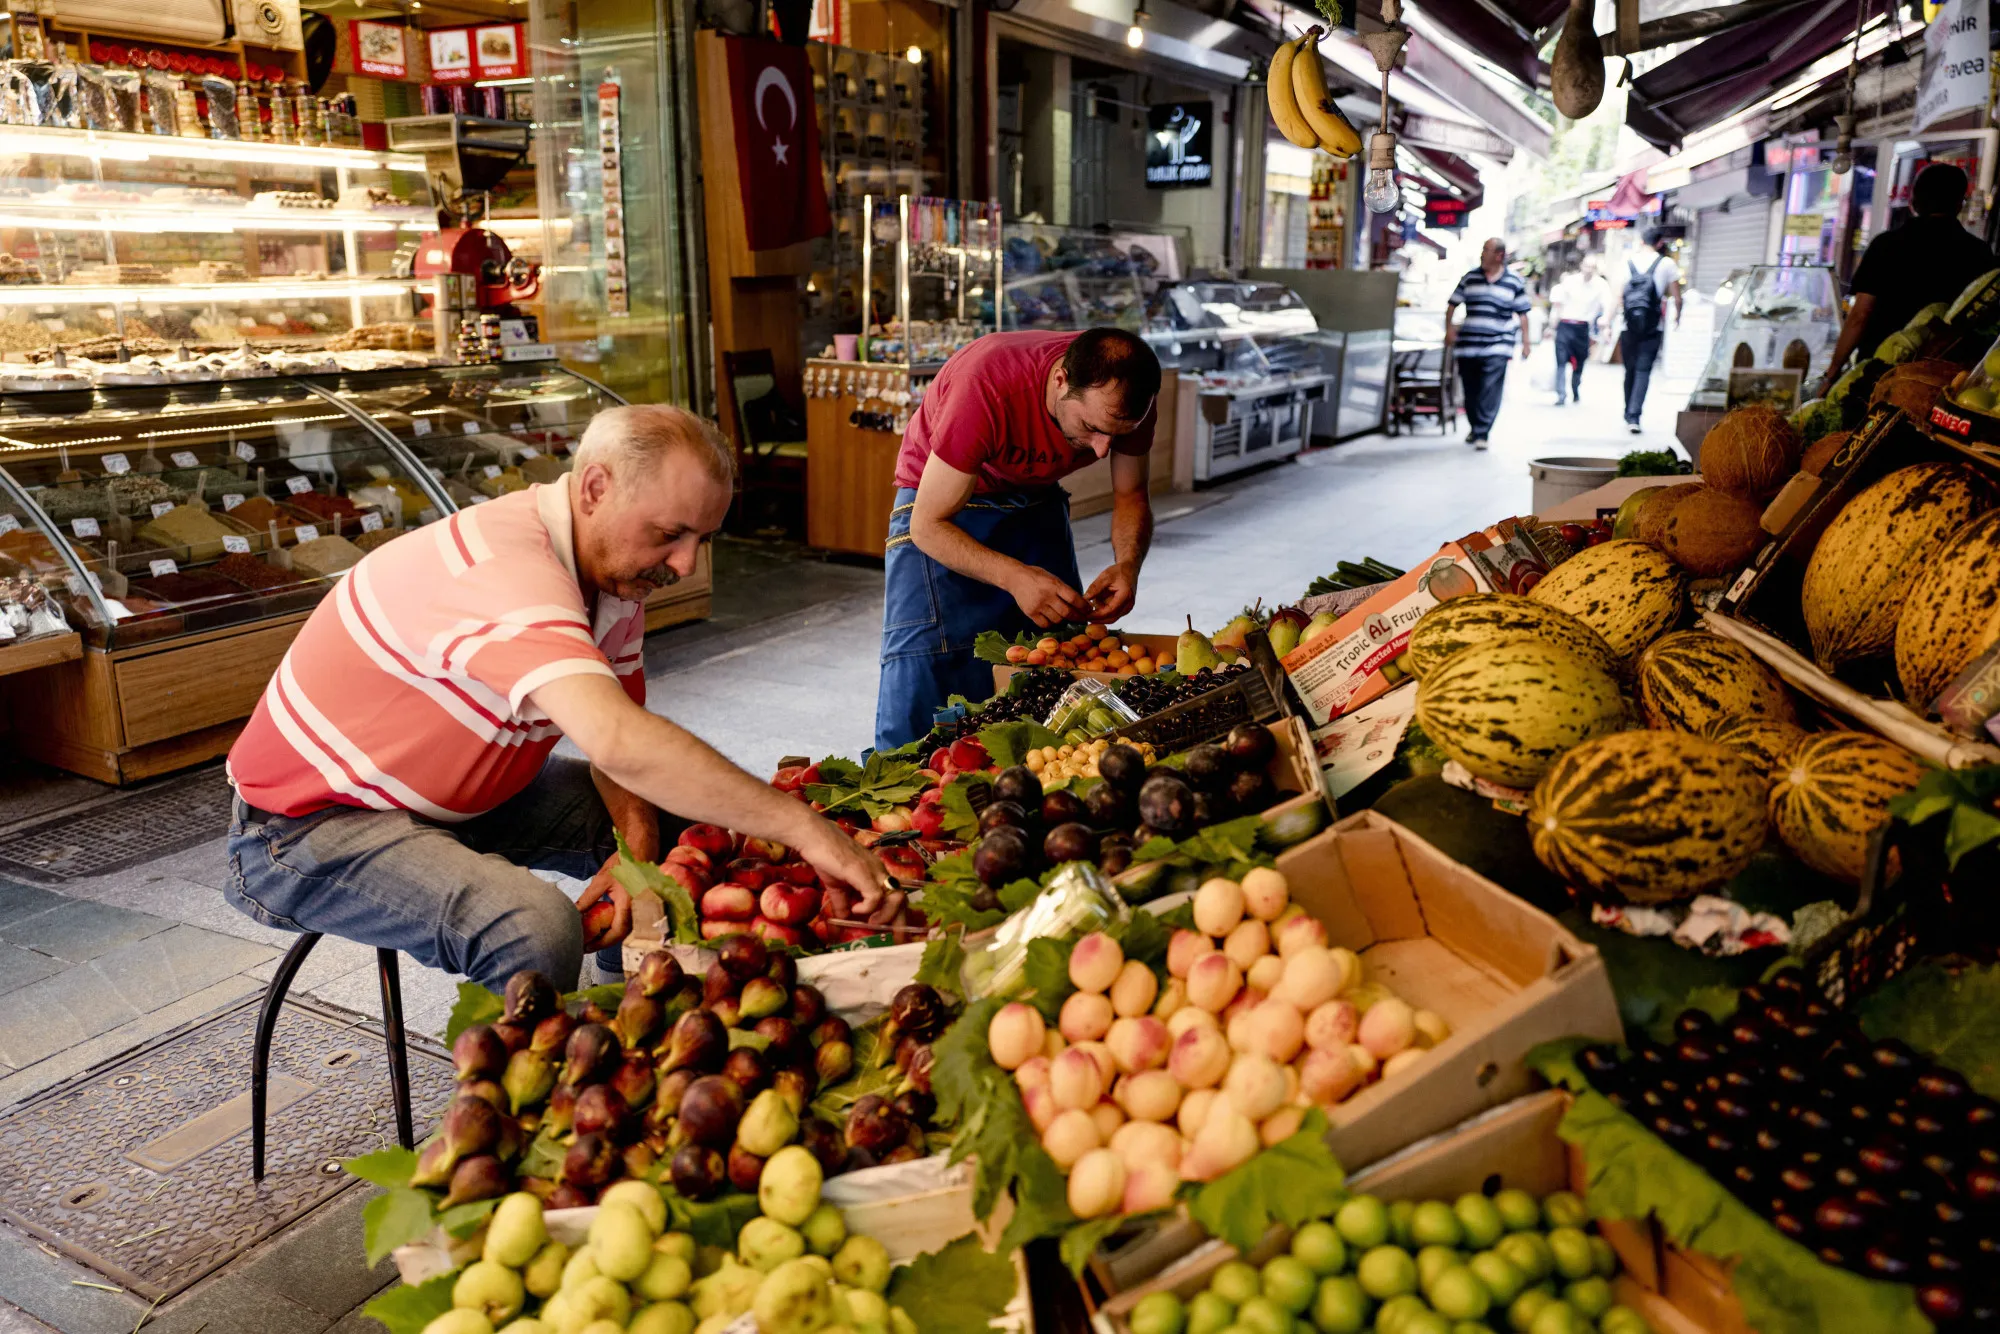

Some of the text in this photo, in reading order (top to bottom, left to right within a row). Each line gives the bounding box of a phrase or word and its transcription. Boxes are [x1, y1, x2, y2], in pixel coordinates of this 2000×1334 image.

[1336, 638, 1371, 671] Tropic
[1369, 619, 1391, 640] AL
[1391, 606, 1422, 628] Fruit
[1363, 646, 1393, 672] Selected
